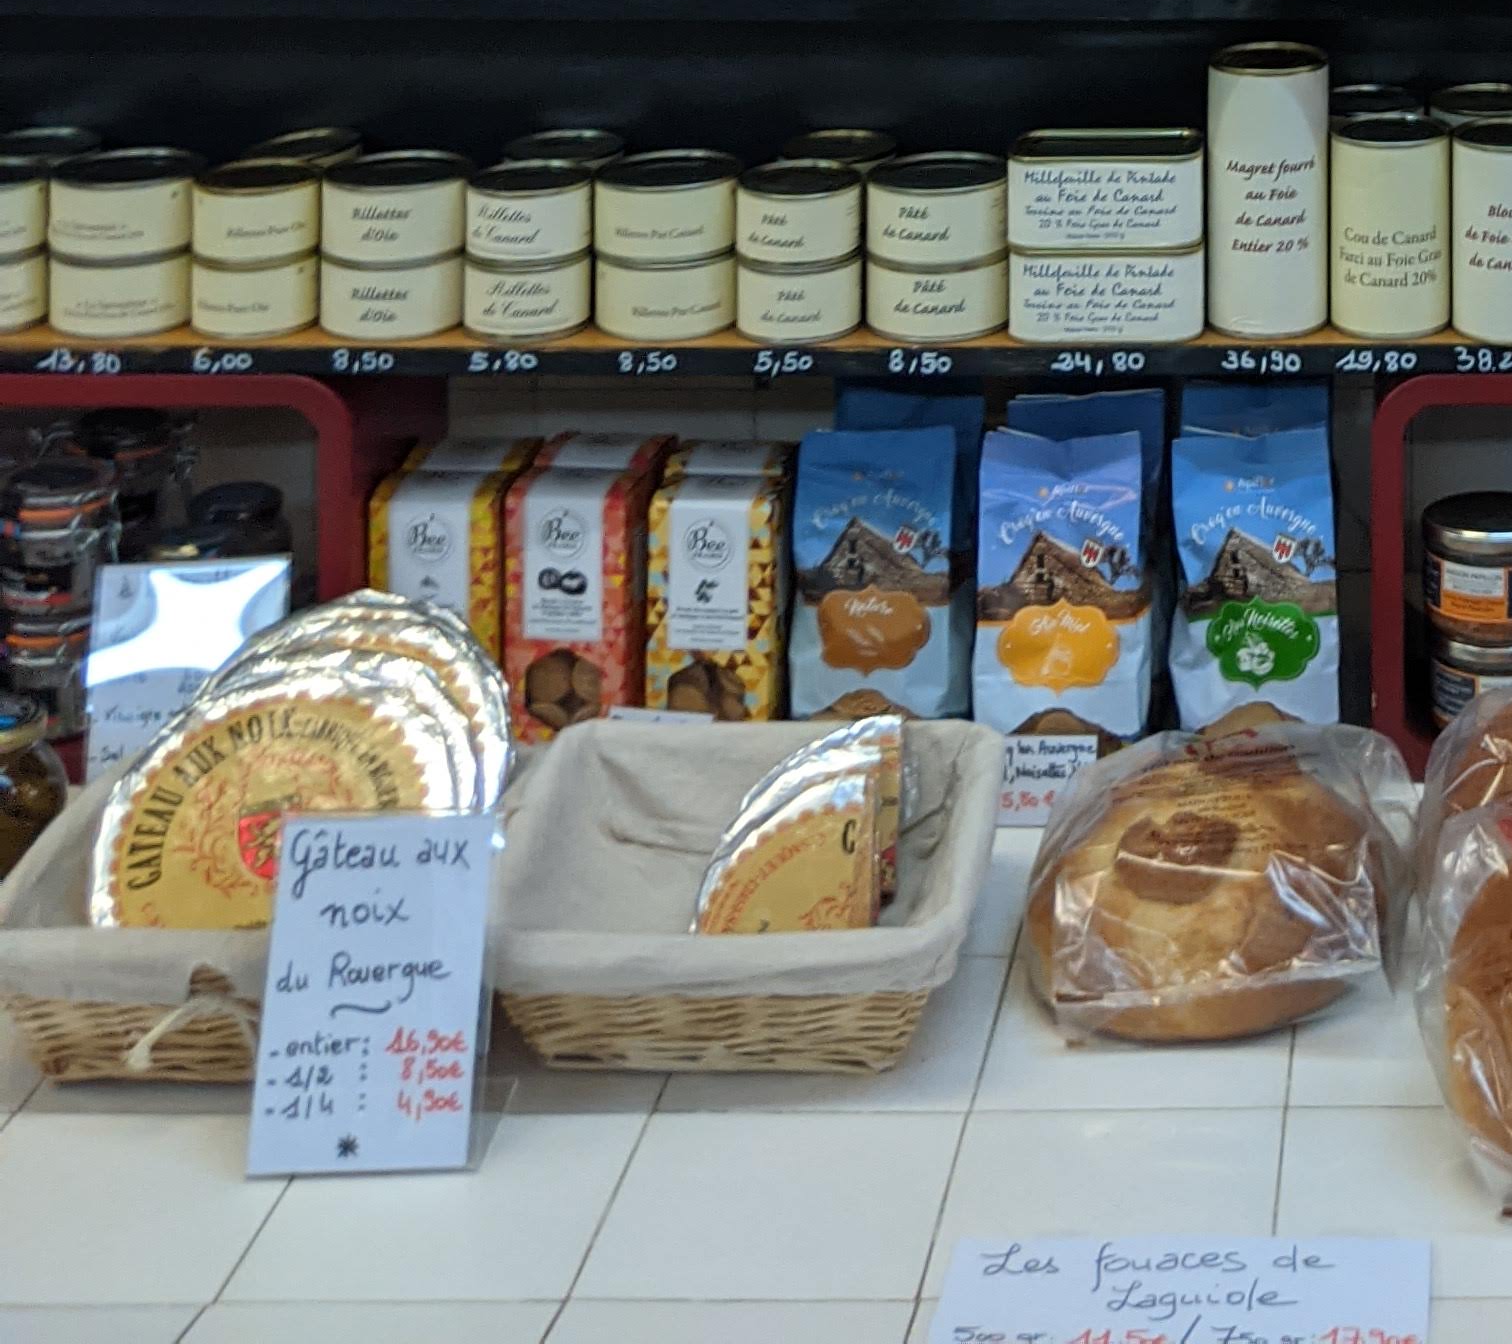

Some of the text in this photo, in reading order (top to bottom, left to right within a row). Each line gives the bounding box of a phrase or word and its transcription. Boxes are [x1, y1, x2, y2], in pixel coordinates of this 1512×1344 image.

[1226, 160, 1275, 180] Magret
[1235, 209, 1307, 227] de Canard
[1231, 237, 1310, 253] Entier 20 %
[1344, 224, 1438, 246] Cou de Canard
[1465, 227, 1479, 240] de
[1480, 229, 1510, 245] Foie
[1468, 254, 1485, 268] de
[616, 350, 678, 374] 8,50
[753, 349, 815, 377] 5,50
[888, 348, 953, 375] 8,50
[1050, 352, 1147, 376] 24,80
[1220, 349, 1303, 374] 36,90
[1335, 350, 1418, 372] 19,80
[1054, 498, 1130, 542] Auvergne
[1246, 498, 1320, 538] Auvergne
[126, 786, 184, 892] GATEAU
[178, 735, 227, 790] AUX
[290, 828, 472, 900] Gâteau aux
[319, 888, 411, 928] noix
[275, 950, 453, 1004] du Rouergue
[980, 1242, 1337, 1292] Les fouaces de
[1106, 1278, 1300, 1322] Laguiole
